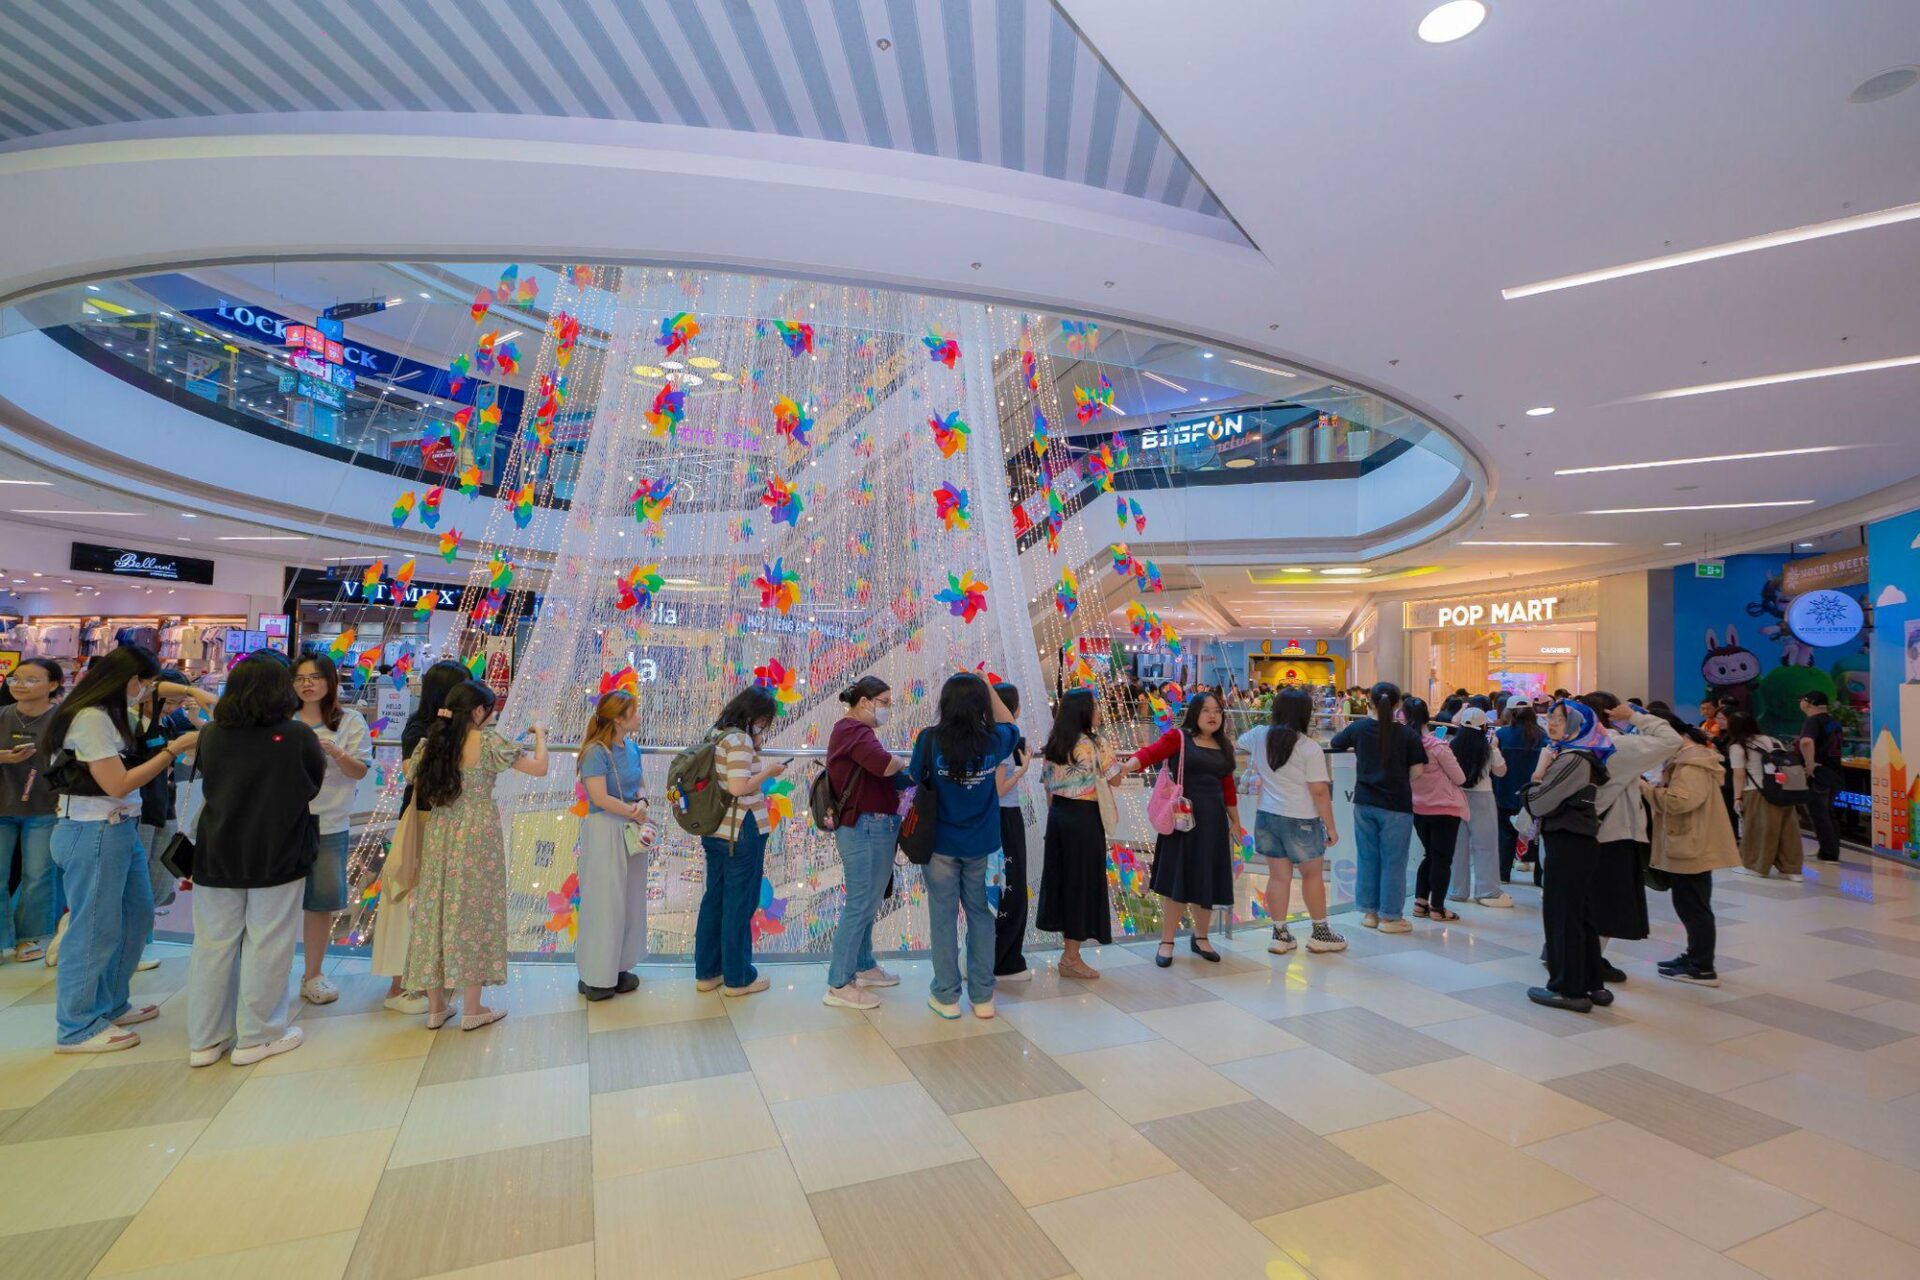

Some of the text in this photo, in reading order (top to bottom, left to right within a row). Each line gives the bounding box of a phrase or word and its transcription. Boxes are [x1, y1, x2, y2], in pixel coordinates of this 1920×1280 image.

[216, 299, 287, 339] LOCK
[343, 346, 377, 370] CK
[1438, 597, 1558, 627] POP MART
